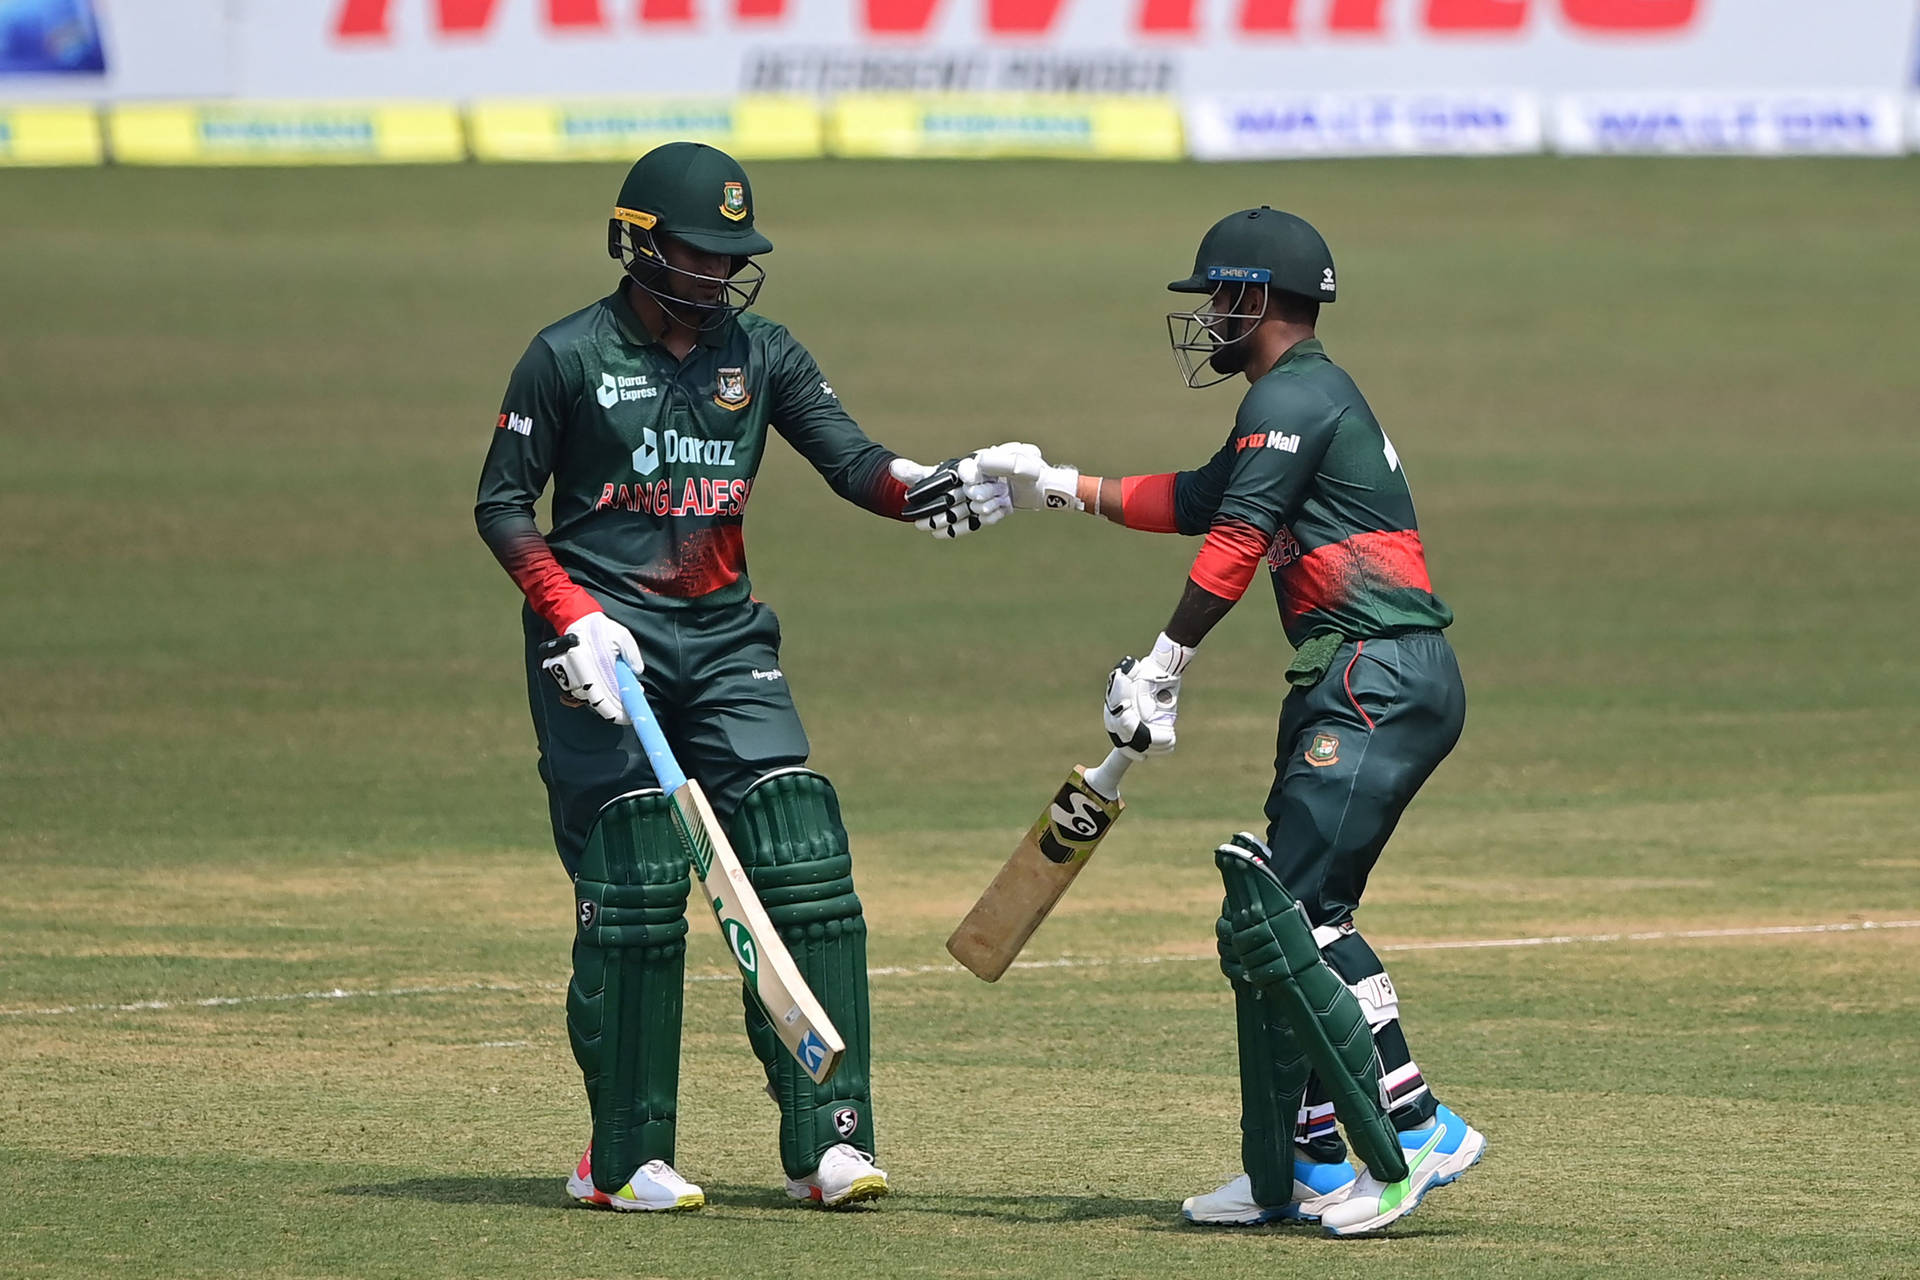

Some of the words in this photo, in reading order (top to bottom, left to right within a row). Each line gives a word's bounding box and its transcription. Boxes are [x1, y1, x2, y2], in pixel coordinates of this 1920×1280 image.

[1220, 269, 1249, 277] SHREY
[617, 375, 648, 387] Daraz
[620, 387, 657, 402] Express
[507, 411, 533, 436] Mall
[663, 429, 736, 466] Daraz
[1266, 430, 1301, 454] Mall
[1051, 792, 1104, 837] SG
